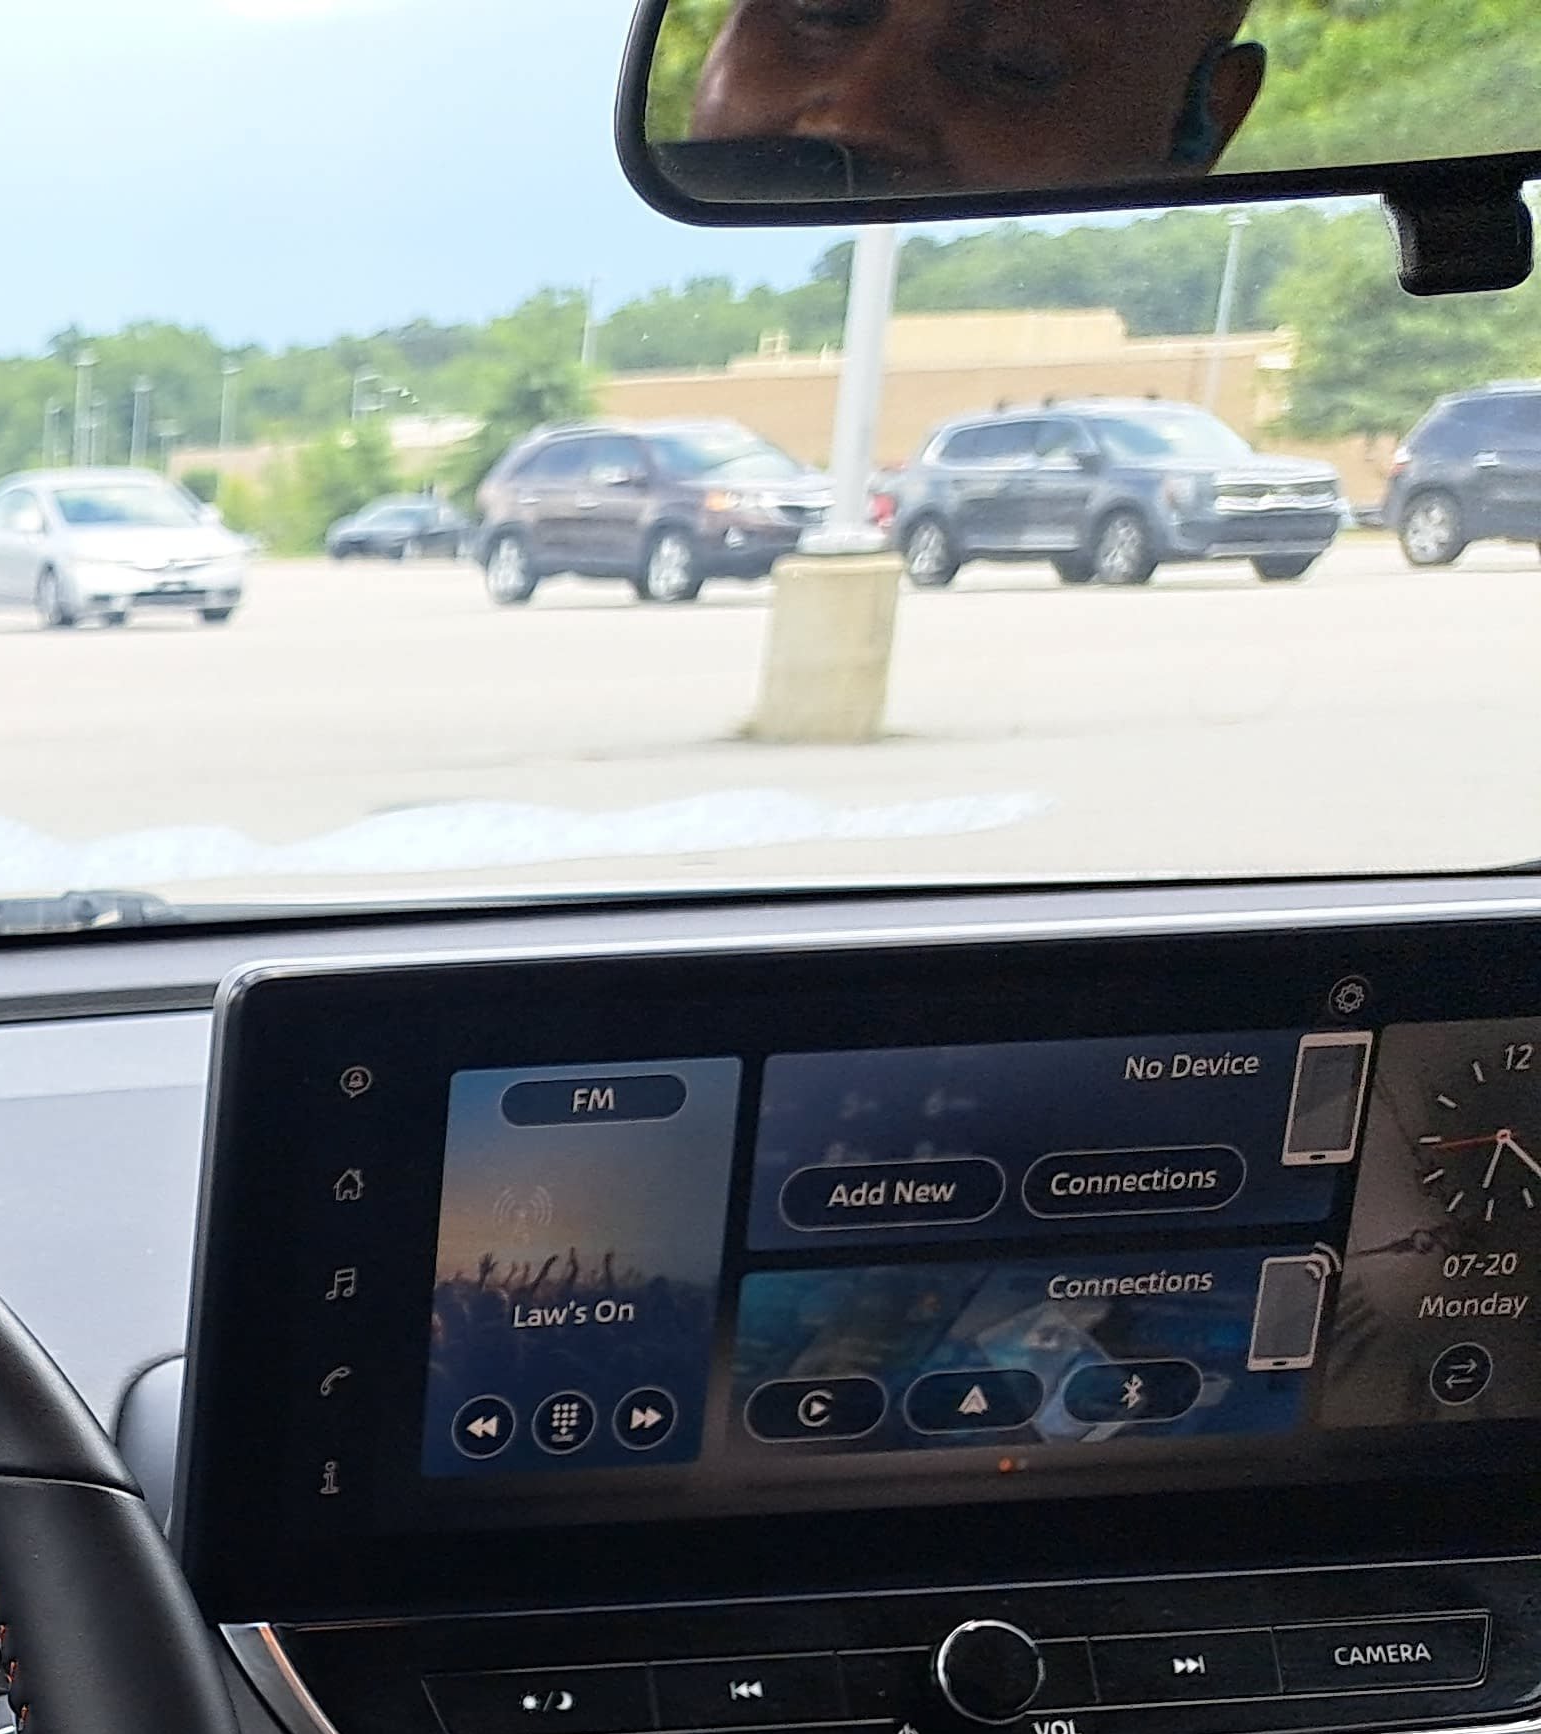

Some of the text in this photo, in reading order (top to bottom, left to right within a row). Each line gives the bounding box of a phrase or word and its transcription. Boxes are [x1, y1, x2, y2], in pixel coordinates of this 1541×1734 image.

[1124, 1052, 1260, 1081] No Device
[1505, 1044, 1533, 1071] 12
[571, 1088, 616, 1114] FM
[827, 1179, 957, 1208] Add New
[1050, 1166, 1217, 1197] Connections
[1443, 1252, 1518, 1279] 07-20
[1047, 1270, 1214, 1299] Connections
[513, 1300, 635, 1329] Law's On
[1419, 1291, 1528, 1320] Monday
[1333, 1642, 1432, 1667] CAMERA
